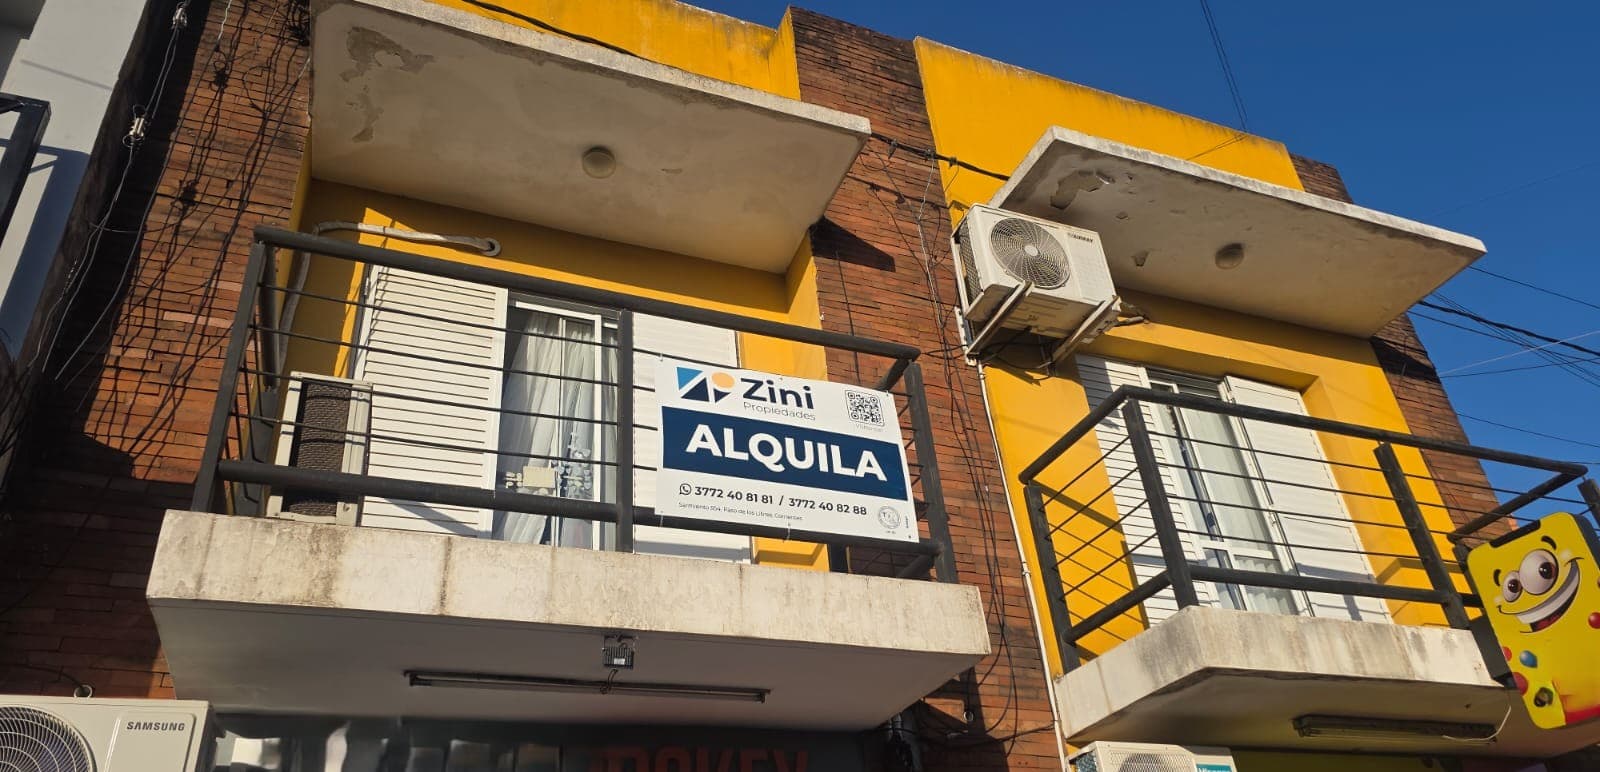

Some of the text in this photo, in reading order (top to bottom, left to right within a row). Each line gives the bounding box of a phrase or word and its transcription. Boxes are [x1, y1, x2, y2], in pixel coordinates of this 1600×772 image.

[740, 377, 814, 410] Zini
[743, 401, 816, 421] Propiedades
[685, 423, 888, 482] ALQUILA
[694, 486, 867, 516] 3772 40 81 81 / 3772 40 82 88
[126, 721, 185, 731] SAMSUNG
